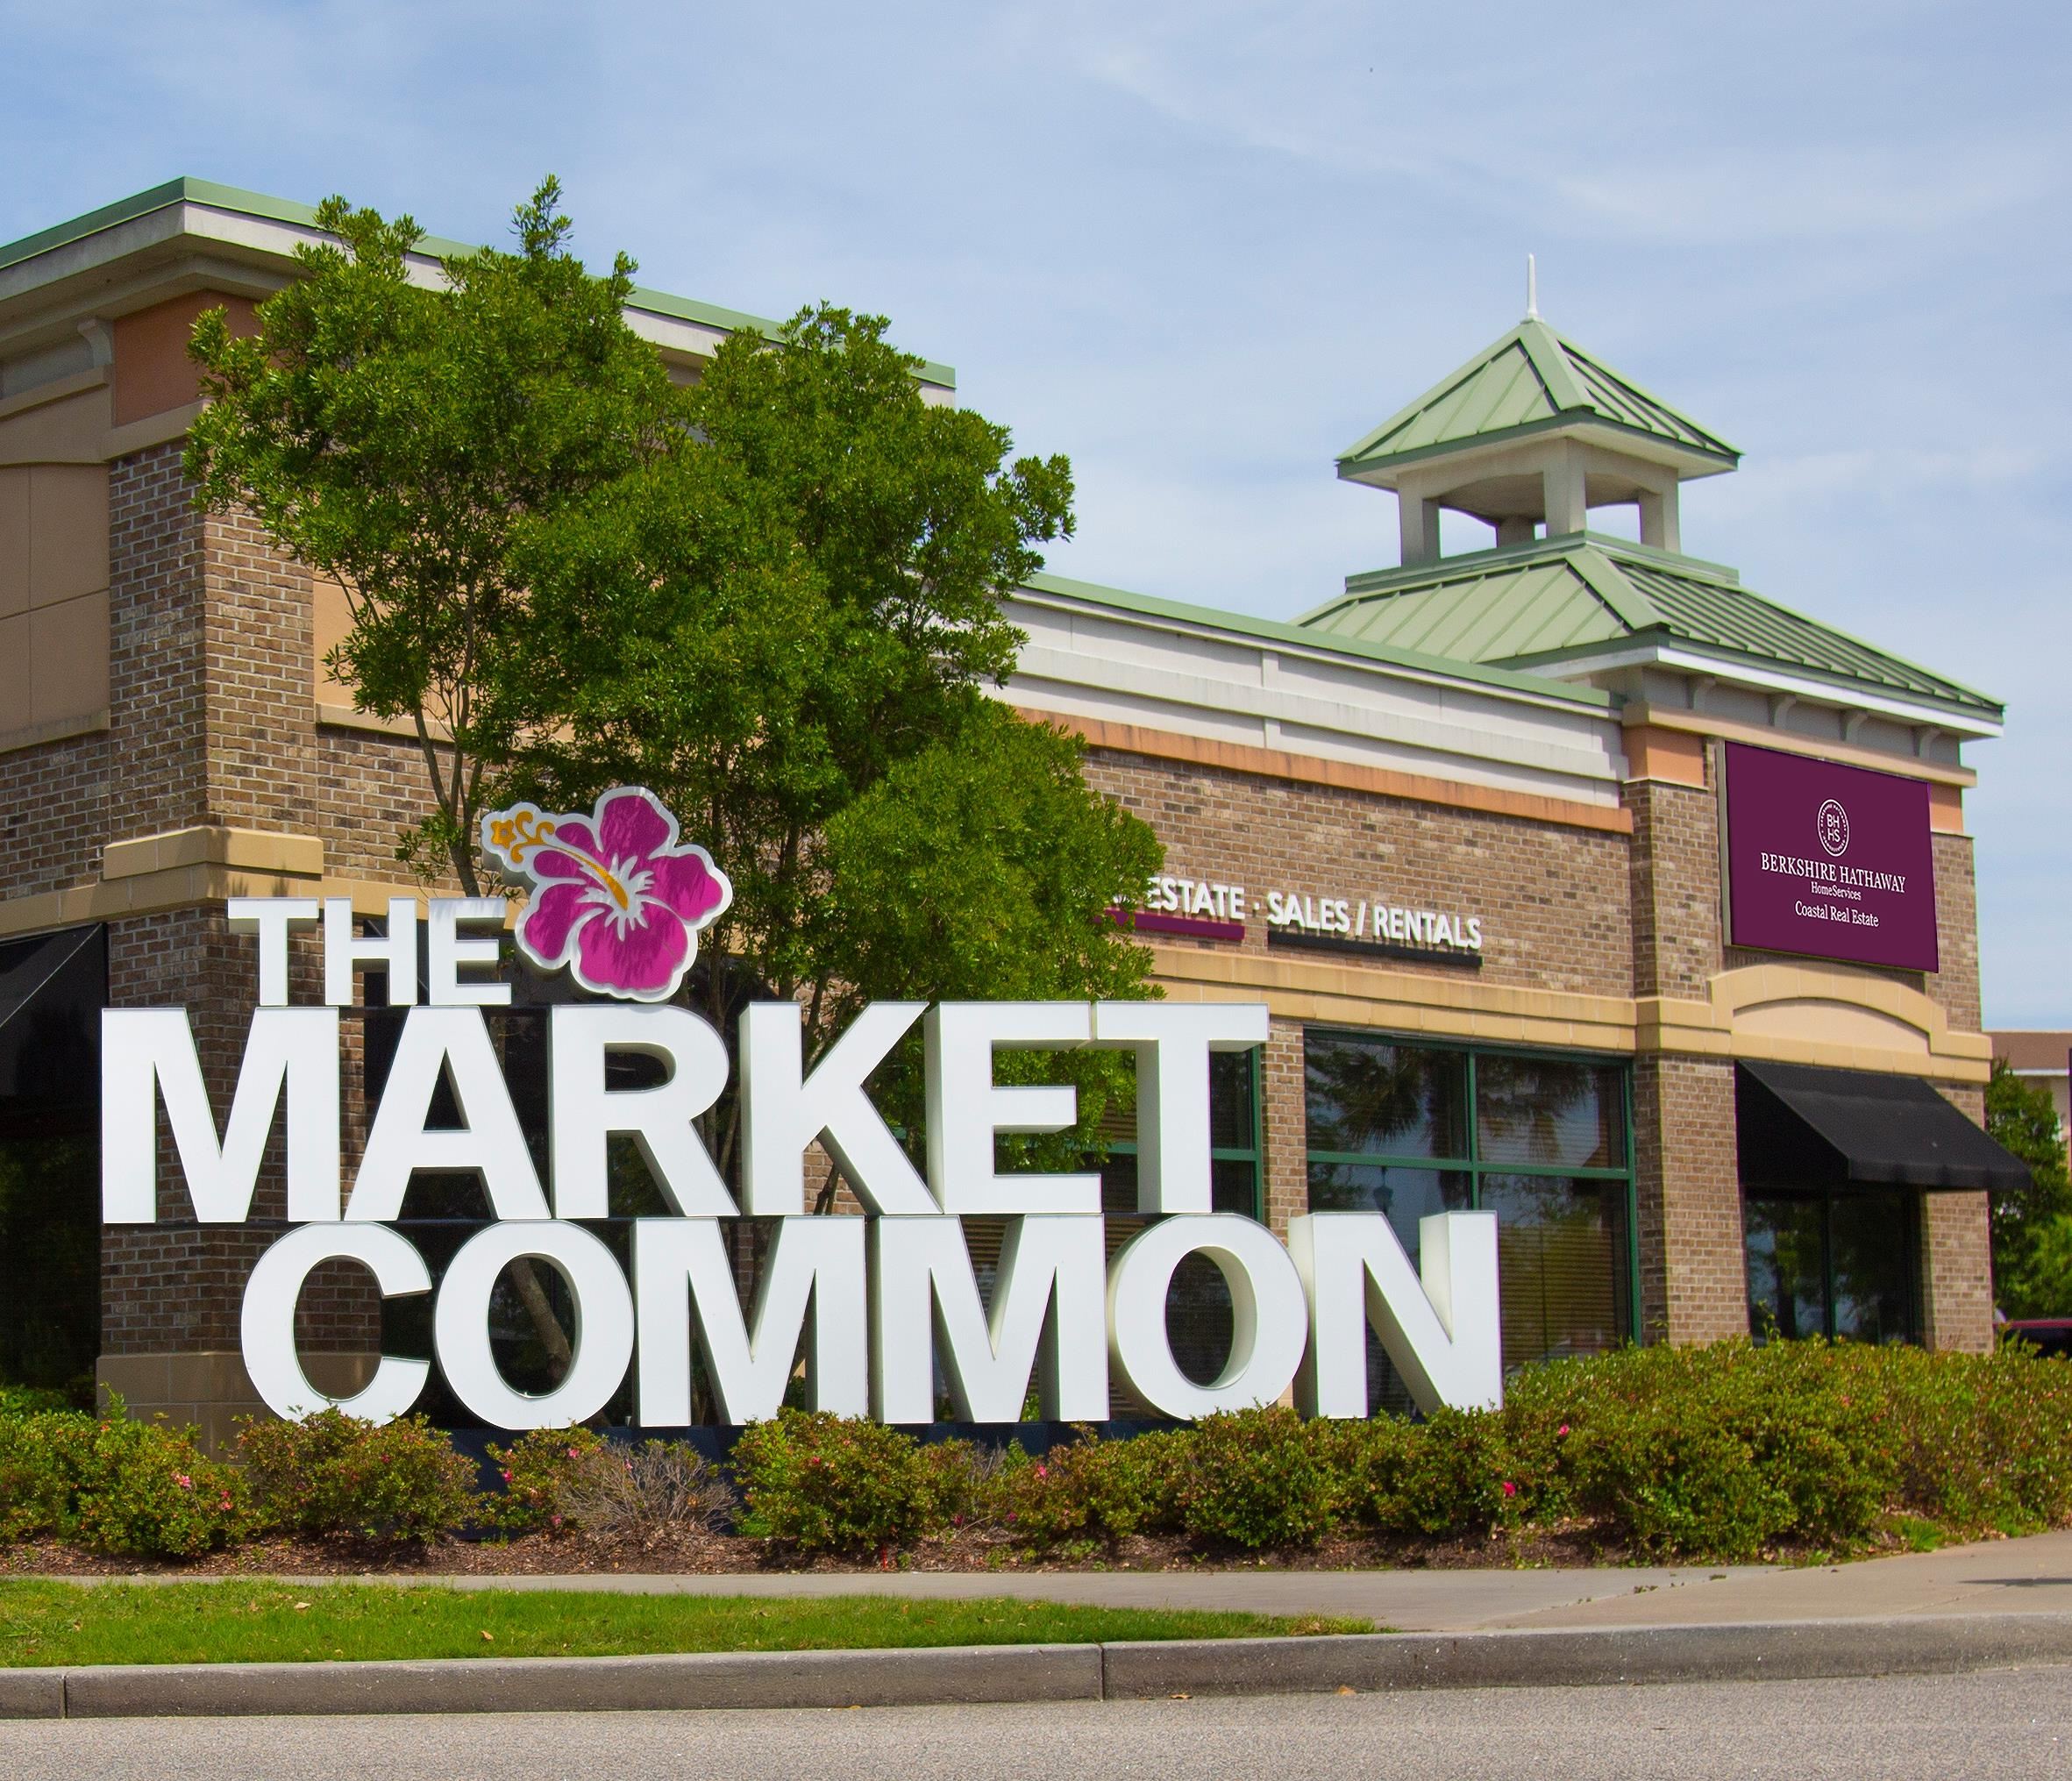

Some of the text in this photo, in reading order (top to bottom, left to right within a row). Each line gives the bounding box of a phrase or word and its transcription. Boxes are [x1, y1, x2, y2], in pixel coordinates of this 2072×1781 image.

[1761, 852, 1906, 894] BERKSHIRE HATHAWAY
[1811, 881, 1862, 901] HomeServices
[1146, 877, 1246, 920] ESTATE
[1266, 892, 1350, 934] SALES
[1371, 905, 1482, 950] RENTALS
[1795, 900, 1879, 927] Coastal Real Estate
[227, 897, 512, 1006] THE
[101, 1001, 1270, 1223] MARKET
[241, 1210, 1503, 1430] COMMON
